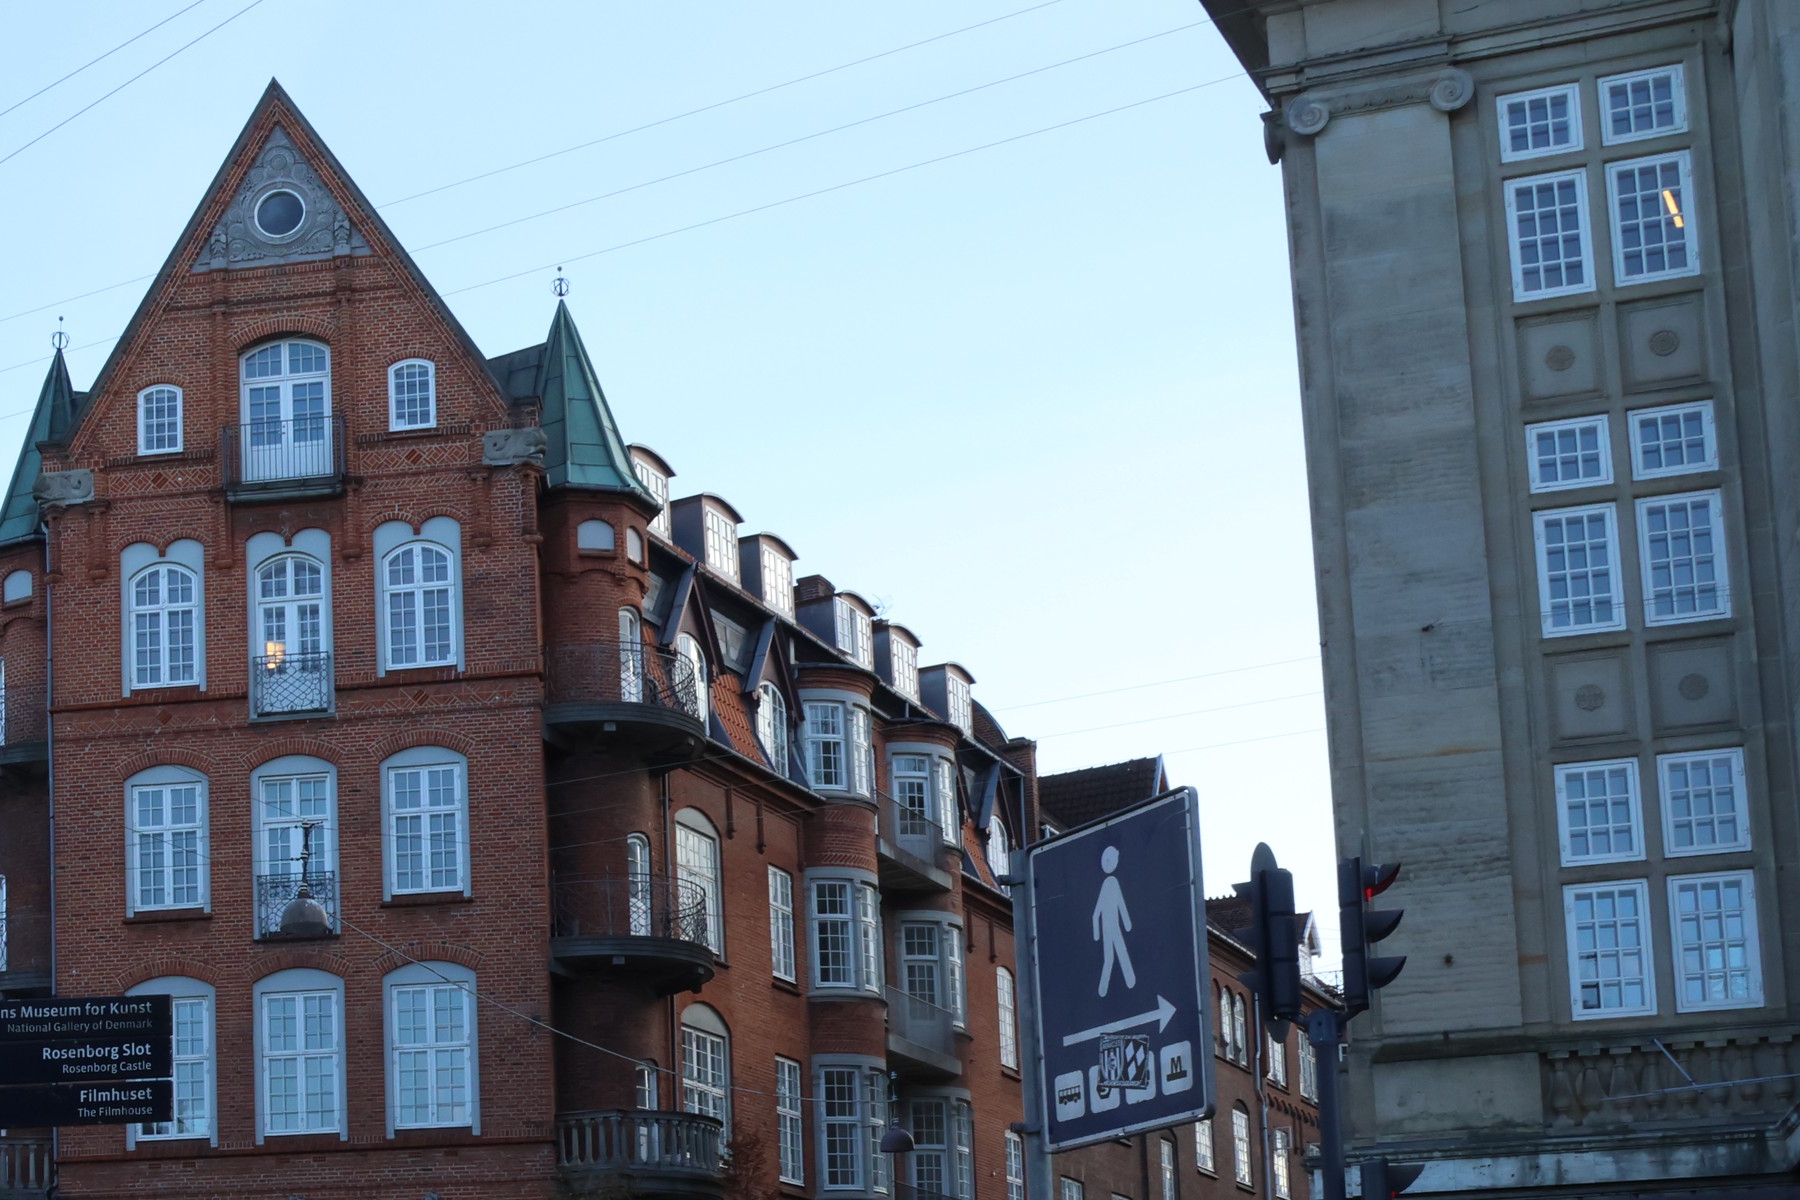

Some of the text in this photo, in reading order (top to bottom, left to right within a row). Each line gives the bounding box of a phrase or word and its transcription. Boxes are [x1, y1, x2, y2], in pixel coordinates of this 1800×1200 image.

[20, 1004, 81, 1019] Museum
[85, 1003, 106, 1015] for
[110, 1001, 152, 1014] Kunst
[7, 1018, 152, 1033] National Gallery of Denmark
[42, 1042, 152, 1060] Rosenborg Slot
[62, 1060, 152, 1074] Rosenborg Castle
[80, 1087, 153, 1102] Filmhuset
[77, 1105, 153, 1117] The Filmhouse
